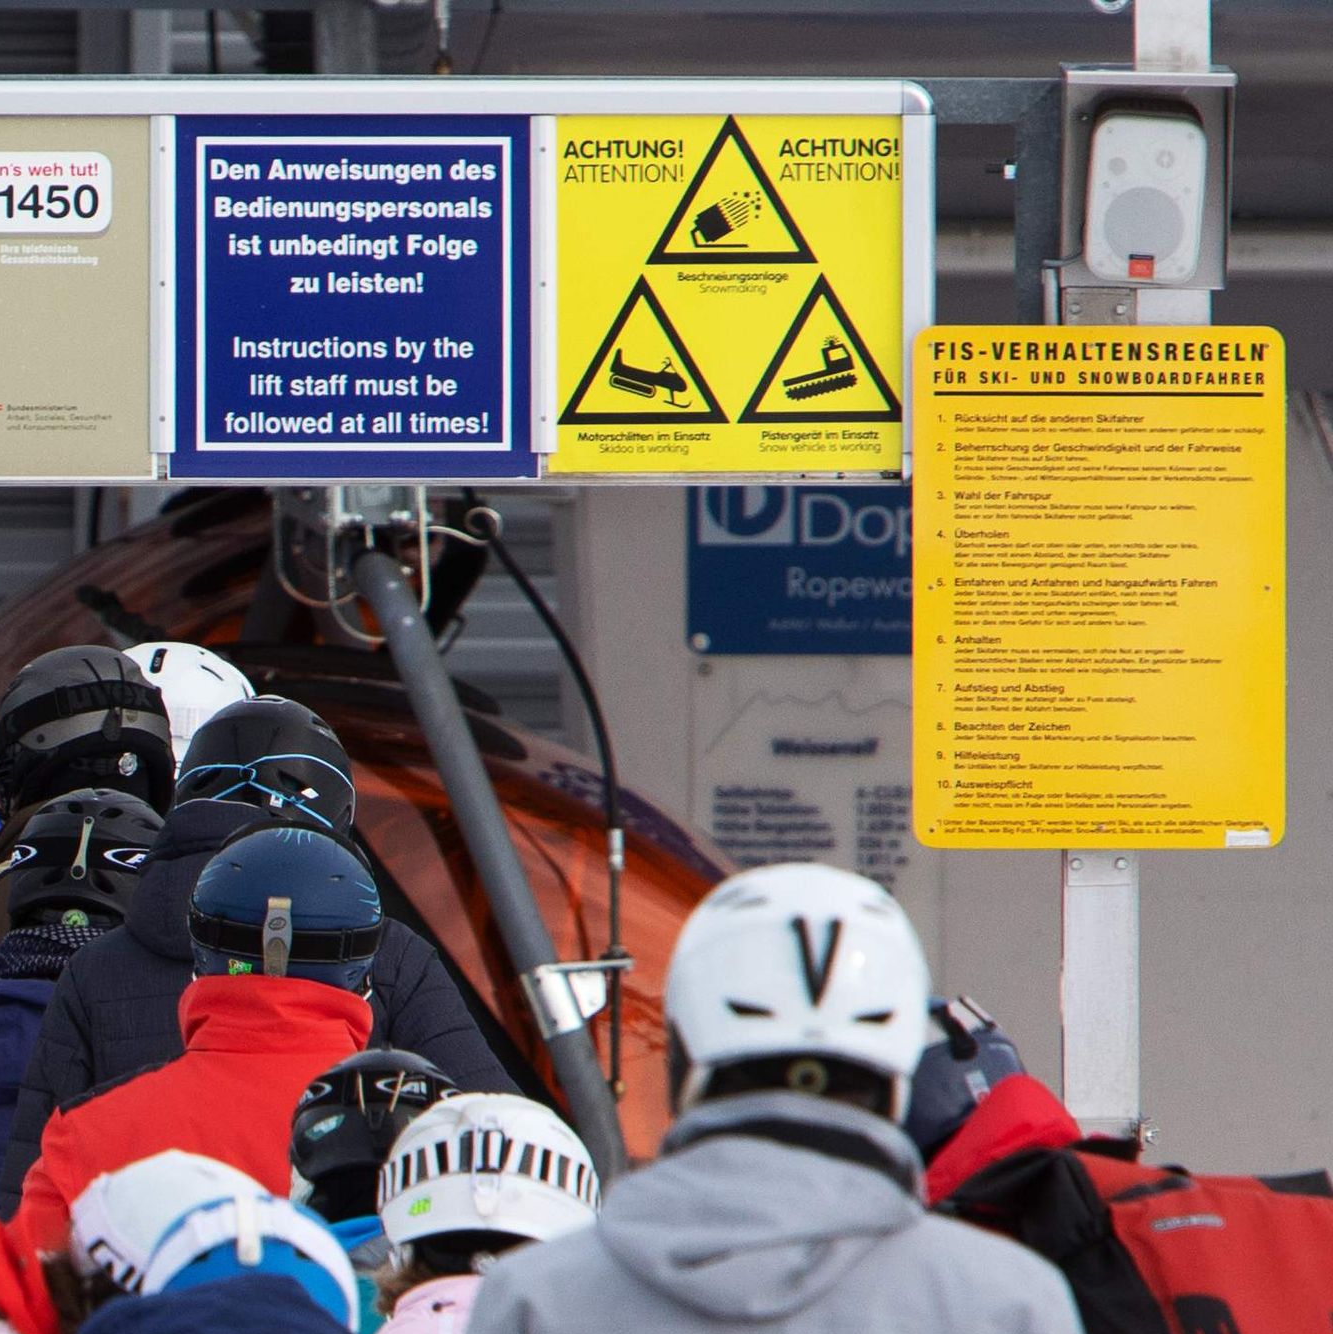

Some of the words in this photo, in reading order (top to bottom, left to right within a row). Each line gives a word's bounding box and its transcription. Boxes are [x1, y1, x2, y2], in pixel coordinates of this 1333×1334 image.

[564, 139, 683, 158] ACHTUNG!
[780, 139, 899, 157] ACHTUNG!
[28, 163, 63, 176] weh
[70, 163, 98, 176] tut!
[211, 159, 259, 179] Den
[268, 159, 441, 184] Anweisungen
[450, 159, 496, 179] des
[564, 164, 683, 183] ATTENTION!
[780, 162, 899, 181] ATTENTION!
[215, 197, 492, 222] Bedienungspersonals
[229, 234, 261, 255] ist
[269, 234, 398, 259] unbedingt
[407, 235, 477, 259] Folge
[290, 278, 318, 293] zu
[328, 272, 424, 293] leisten!
[678, 272, 789, 284] Beschneiungsanlage
[699, 283, 766, 294] Snowmaking
[233, 337, 387, 358] Instructions
[396, 337, 425, 363] by
[434, 337, 474, 358] the
[934, 342, 1265, 361] FIS-VERHALTENSREGELN
[934, 369, 967, 384] FÜR
[980, 371, 1017, 384] SKI-
[1031, 371, 1065, 384] UND
[1079, 371, 1265, 385] SNOWBOARDFAHRER
[250, 375, 282, 396] lift
[290, 375, 347, 396] staff
[355, 377, 418, 396] must
[427, 375, 457, 396] be
[225, 412, 333, 433] followed
[341, 414, 365, 433] at
[372, 412, 401, 433] all
[410, 412, 489, 433] times!
[954, 414, 1007, 423] Rücksicht
[1011, 414, 1029, 423] auf
[1032, 414, 1046, 423] die
[1049, 415, 1093, 423] anderen
[1097, 414, 1144, 424] Skifahrer
[578, 432, 654, 442] Motorschlitten
[658, 432, 671, 441] im
[674, 431, 710, 441] Einsatz
[762, 430, 822, 442] Pistengerät
[825, 431, 839, 440] im
[842, 430, 879, 440] Einsatz
[637, 444, 645, 453] is
[648, 444, 688, 455] working
[760, 442, 787, 452] Snow
[790, 442, 826, 452] vehicle
[829, 442, 837, 452] is
[840, 442, 881, 453] working
[1033, 444, 1050, 453] der
[1053, 443, 1141, 454] Geschwindigkeit
[1144, 444, 1164, 453] und
[1168, 444, 1184, 453] der
[1188, 444, 1241, 453] Fahrweise
[954, 491, 981, 500] Wahl
[985, 492, 1001, 500] der
[1004, 492, 1052, 503] Fahrspur
[954, 529, 1009, 539] Überholen
[955, 684, 998, 694] Aufstieg
[1002, 684, 1021, 692] und
[1025, 684, 1064, 694] Abstieg
